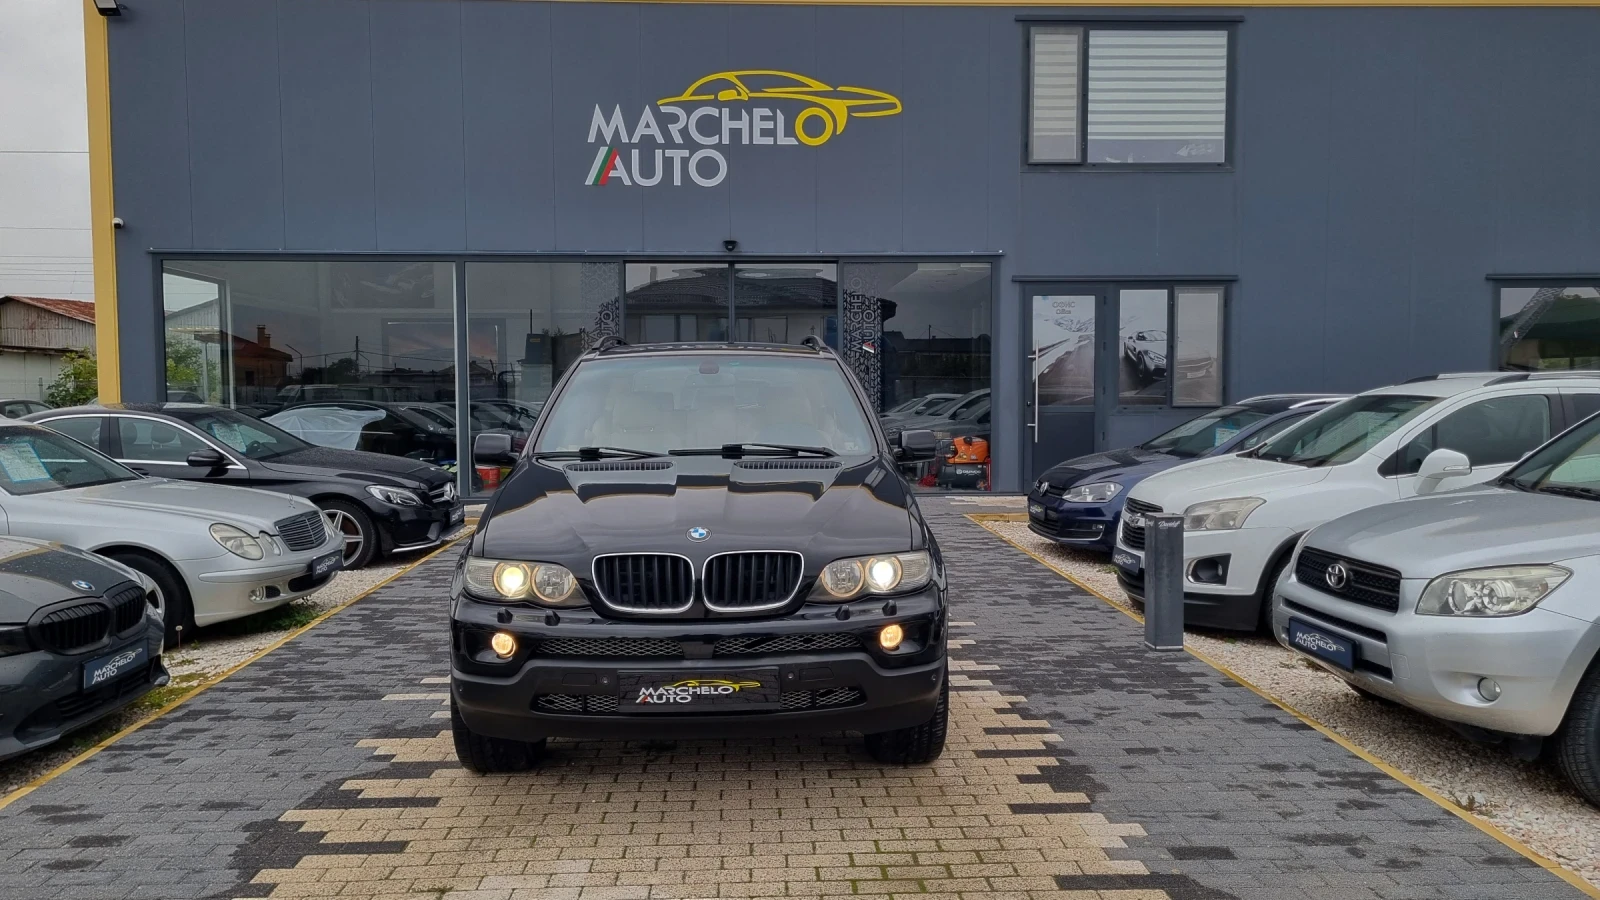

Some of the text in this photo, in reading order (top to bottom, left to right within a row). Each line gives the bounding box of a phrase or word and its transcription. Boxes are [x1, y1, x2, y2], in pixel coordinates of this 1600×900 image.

[587, 103, 834, 146] MARCHELO
[585, 147, 727, 187] AUTO
[862, 310, 875, 354] AUTO
[1295, 637, 1317, 650] AUTO
[1296, 631, 1334, 651] MARCHELO
[93, 655, 133, 677] MARCHELO
[92, 668, 117, 685] AUTO
[636, 695, 692, 703] AUTO
[638, 686, 734, 695] MARCHELO
